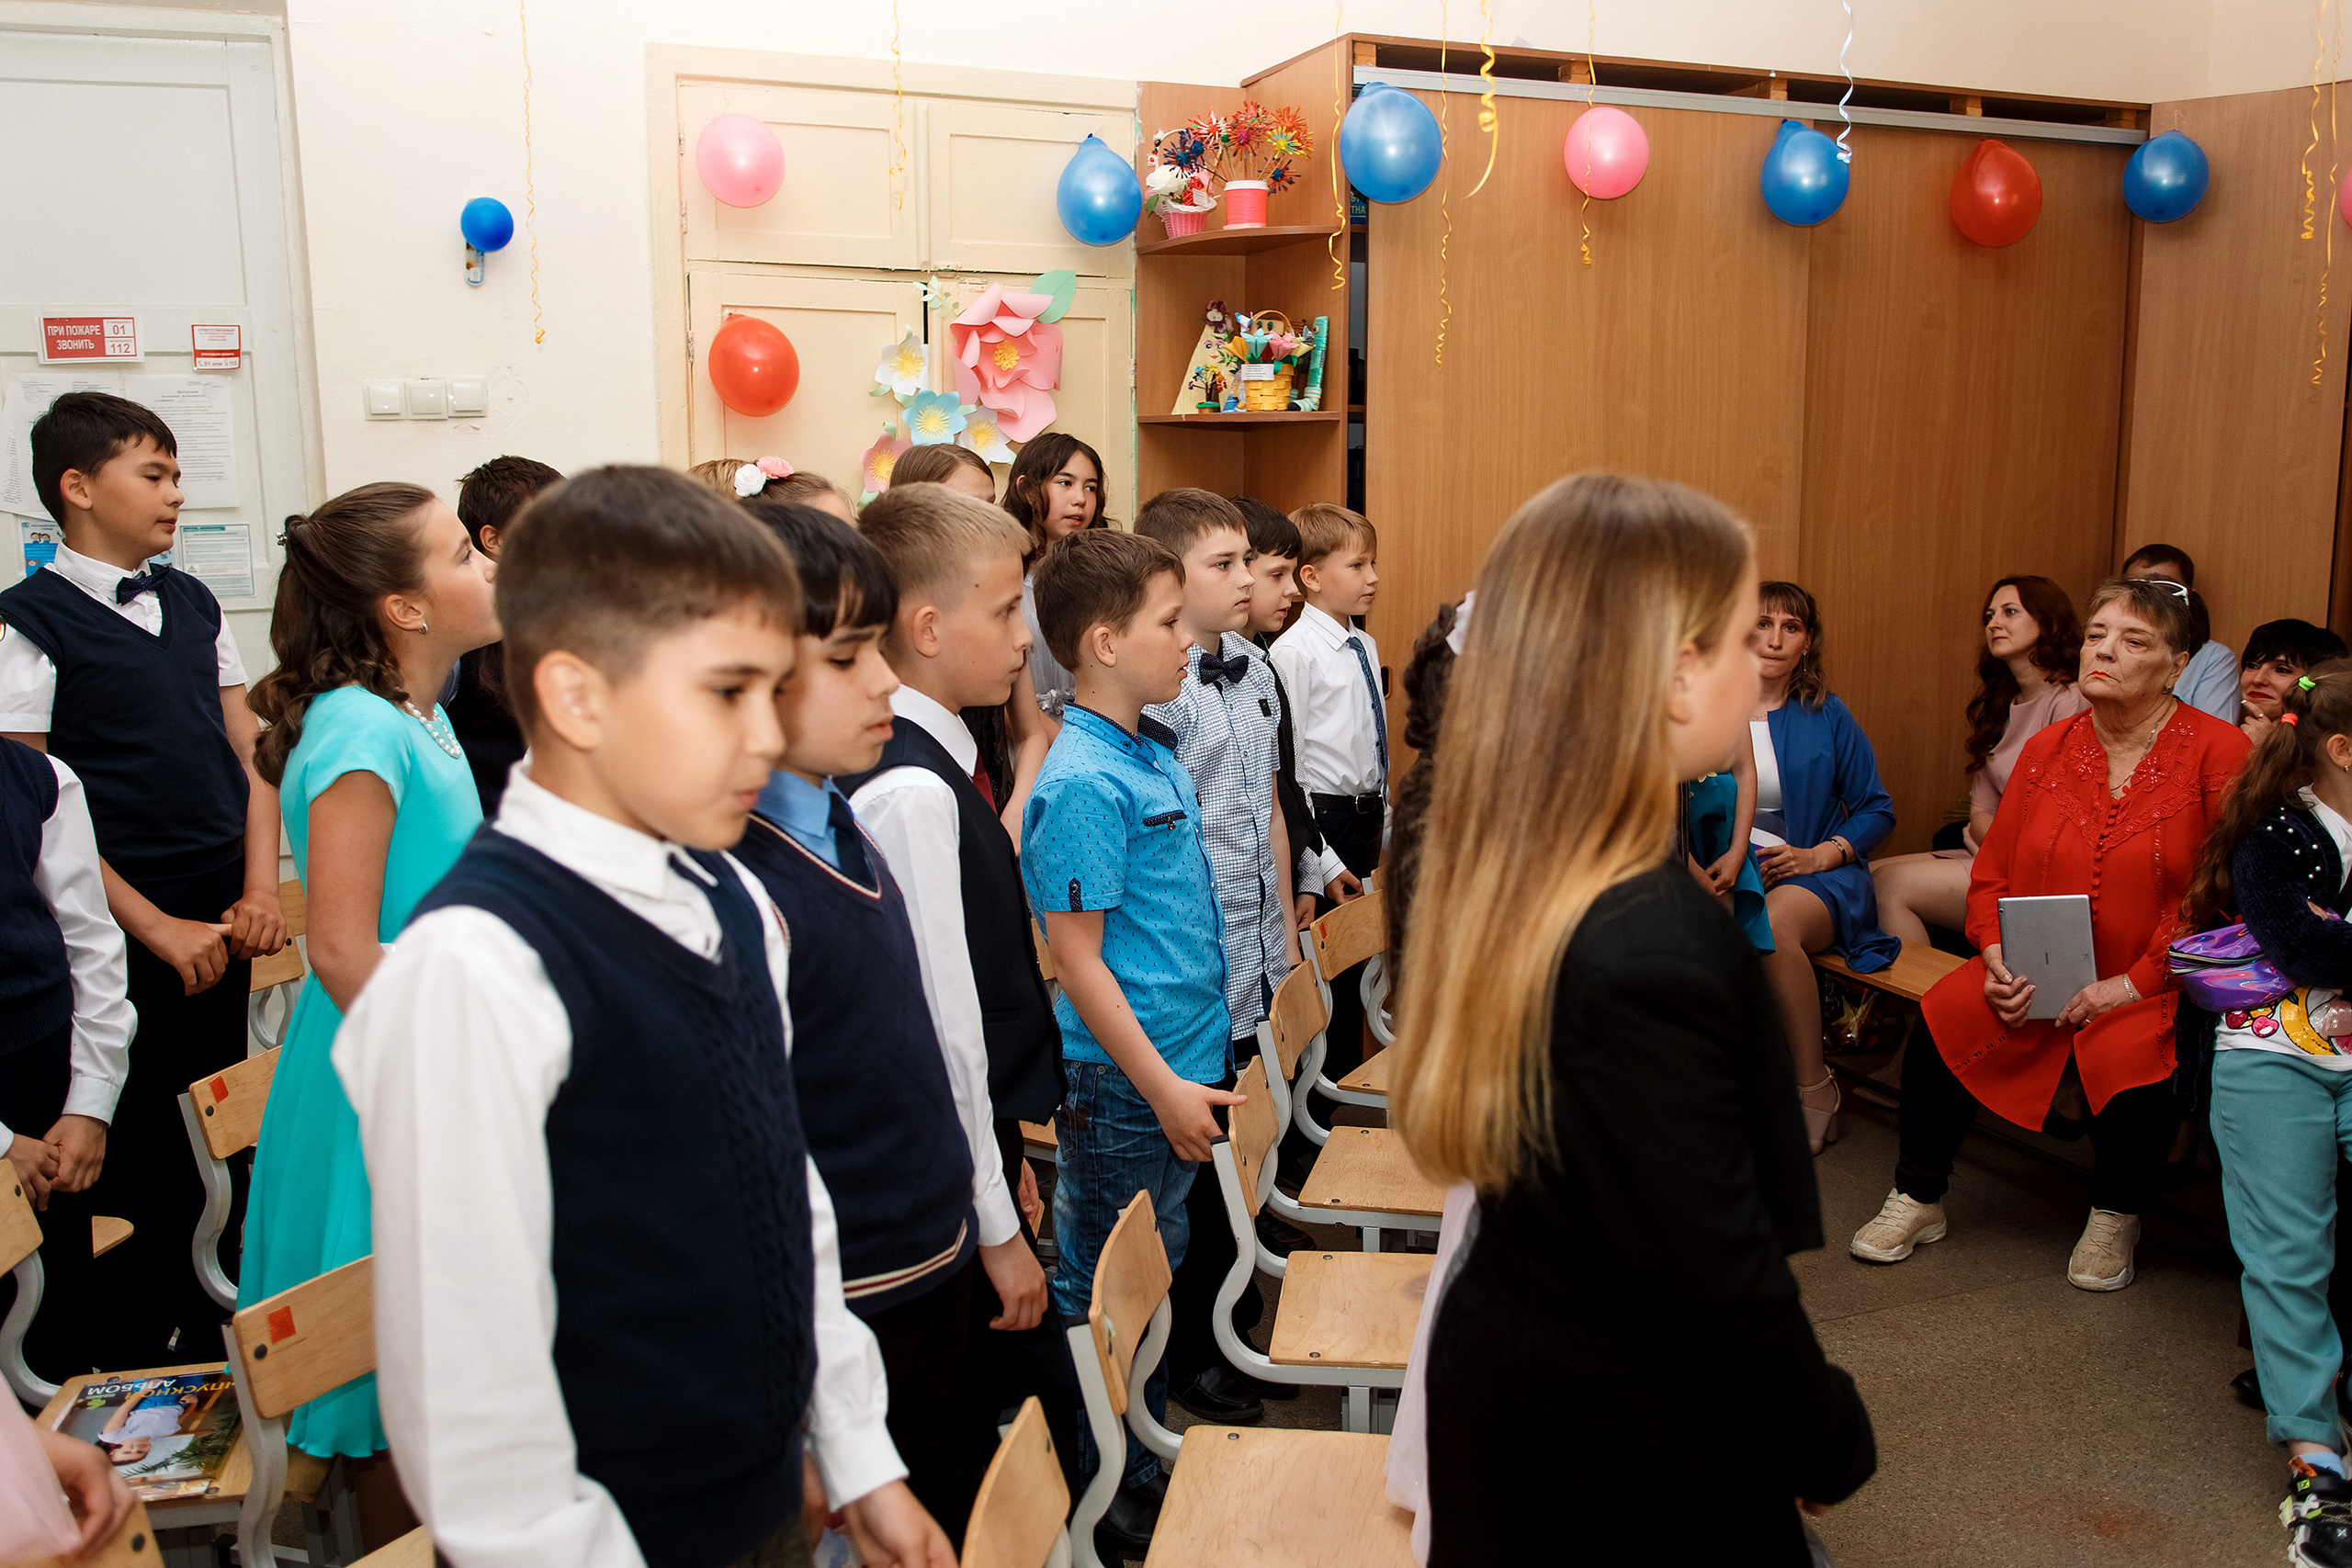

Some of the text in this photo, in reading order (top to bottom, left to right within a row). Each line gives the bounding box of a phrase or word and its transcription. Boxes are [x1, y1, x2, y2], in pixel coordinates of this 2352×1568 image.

[47, 324, 101, 336] ПРИ ПОЖАРЕ
[112, 324, 126, 335] 01
[56, 339, 95, 350] ЗВОНИТЬ
[109, 343, 130, 354] 112
[87, 1379, 177, 1395] АЛЬБОМ
[125, 1382, 235, 1401] ЫПУСКНОЙ
